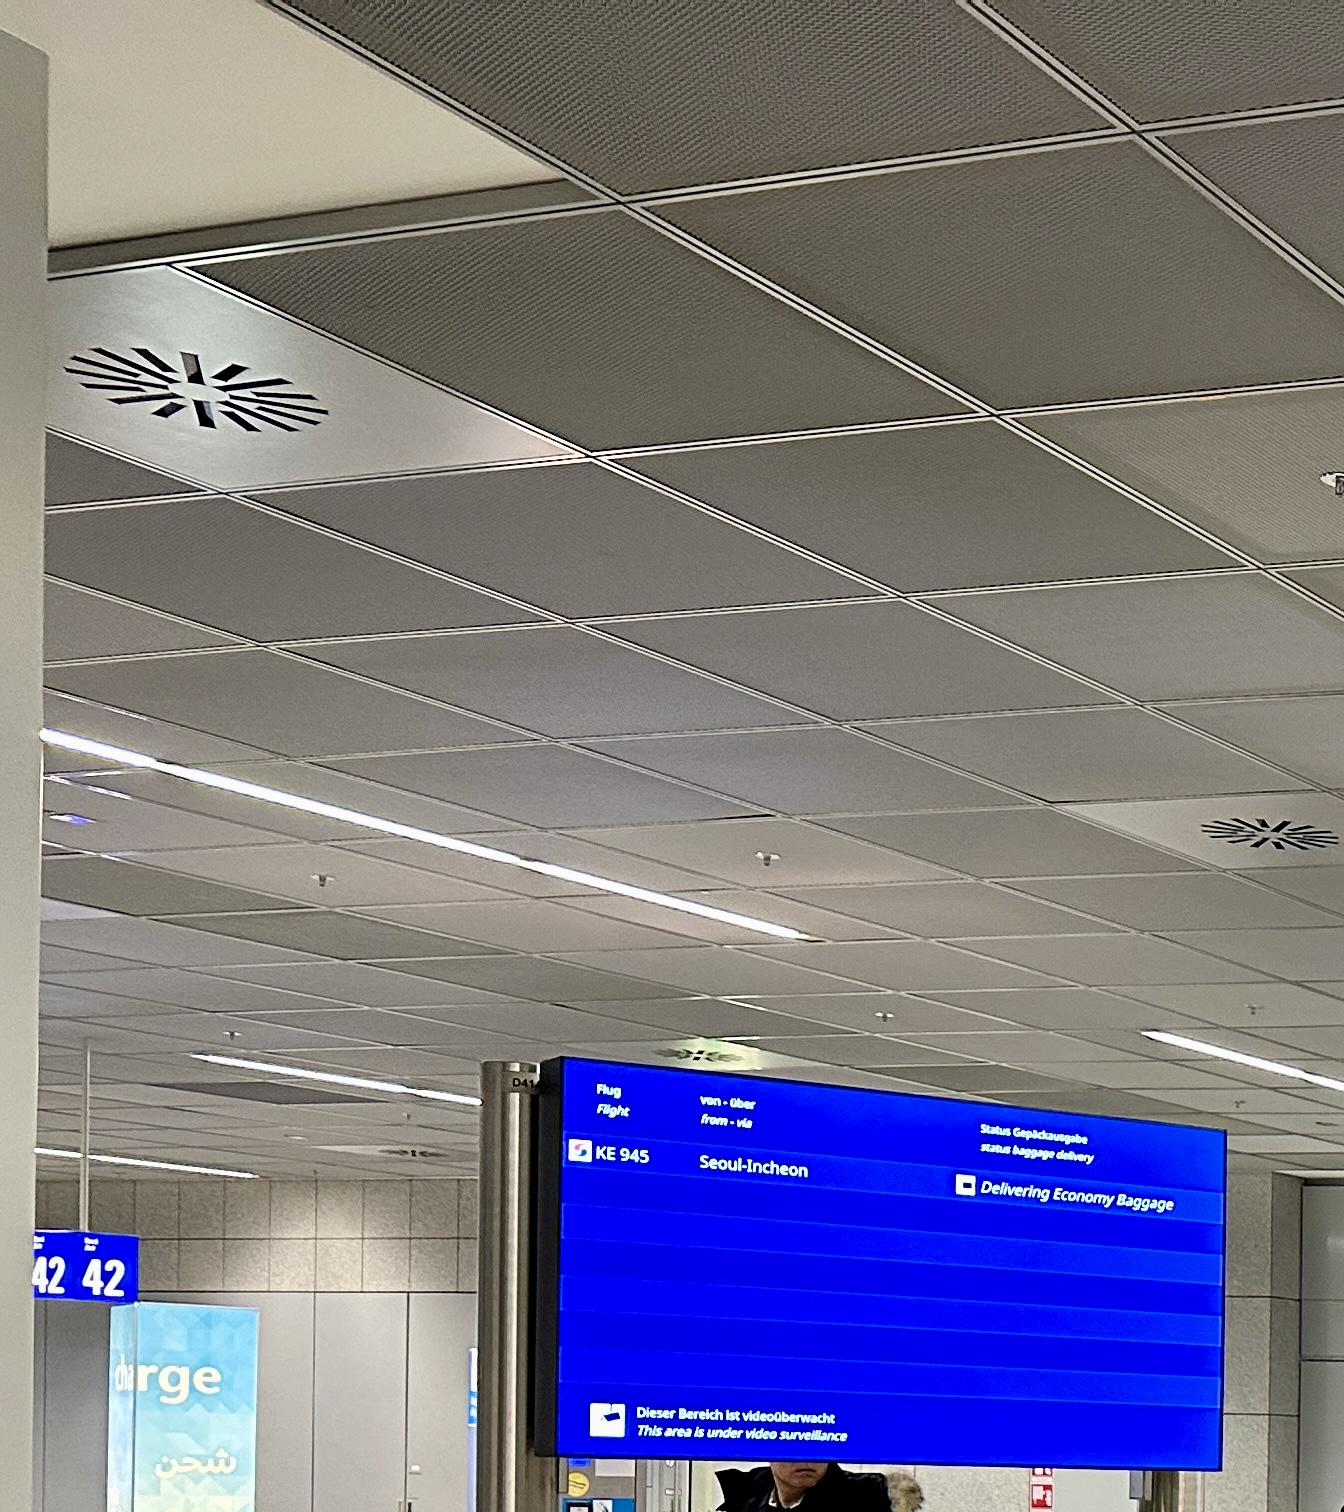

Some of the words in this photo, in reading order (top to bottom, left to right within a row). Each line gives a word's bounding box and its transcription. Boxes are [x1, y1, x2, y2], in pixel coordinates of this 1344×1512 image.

[597, 1084, 621, 1099] Flug
[597, 1104, 630, 1118] Flight
[700, 1096, 721, 1108] von
[730, 1097, 756, 1110] über
[701, 1114, 728, 1127] from
[736, 1117, 753, 1129] via
[980, 1124, 1011, 1137] Status
[1013, 1127, 1088, 1145] Gepäckausgabe
[596, 1146, 616, 1161] KE
[620, 1147, 649, 1164] 945
[980, 1143, 1011, 1155] status
[1012, 1145, 1055, 1160] baggage
[1056, 1150, 1094, 1165] delivery
[699, 1154, 808, 1178] Seoul-Incheon
[981, 1180, 1051, 1203] Delivering
[1053, 1187, 1115, 1208] Economy
[1116, 1194, 1174, 1213] Baggage
[32, 1256, 66, 1294] 42
[82, 1259, 125, 1297] 42
[637, 1406, 676, 1420] Dieser
[678, 1408, 723, 1421] Bereich
[726, 1409, 740, 1422] ist
[742, 1410, 836, 1425] videoüberwacht
[637, 1425, 662, 1438] This
[664, 1427, 692, 1439] area
[694, 1426, 704, 1438] is
[706, 1427, 743, 1440] under
[745, 1428, 777, 1441] video
[779, 1429, 847, 1442] surveillance
[155, 1448, 236, 1479] شحن
